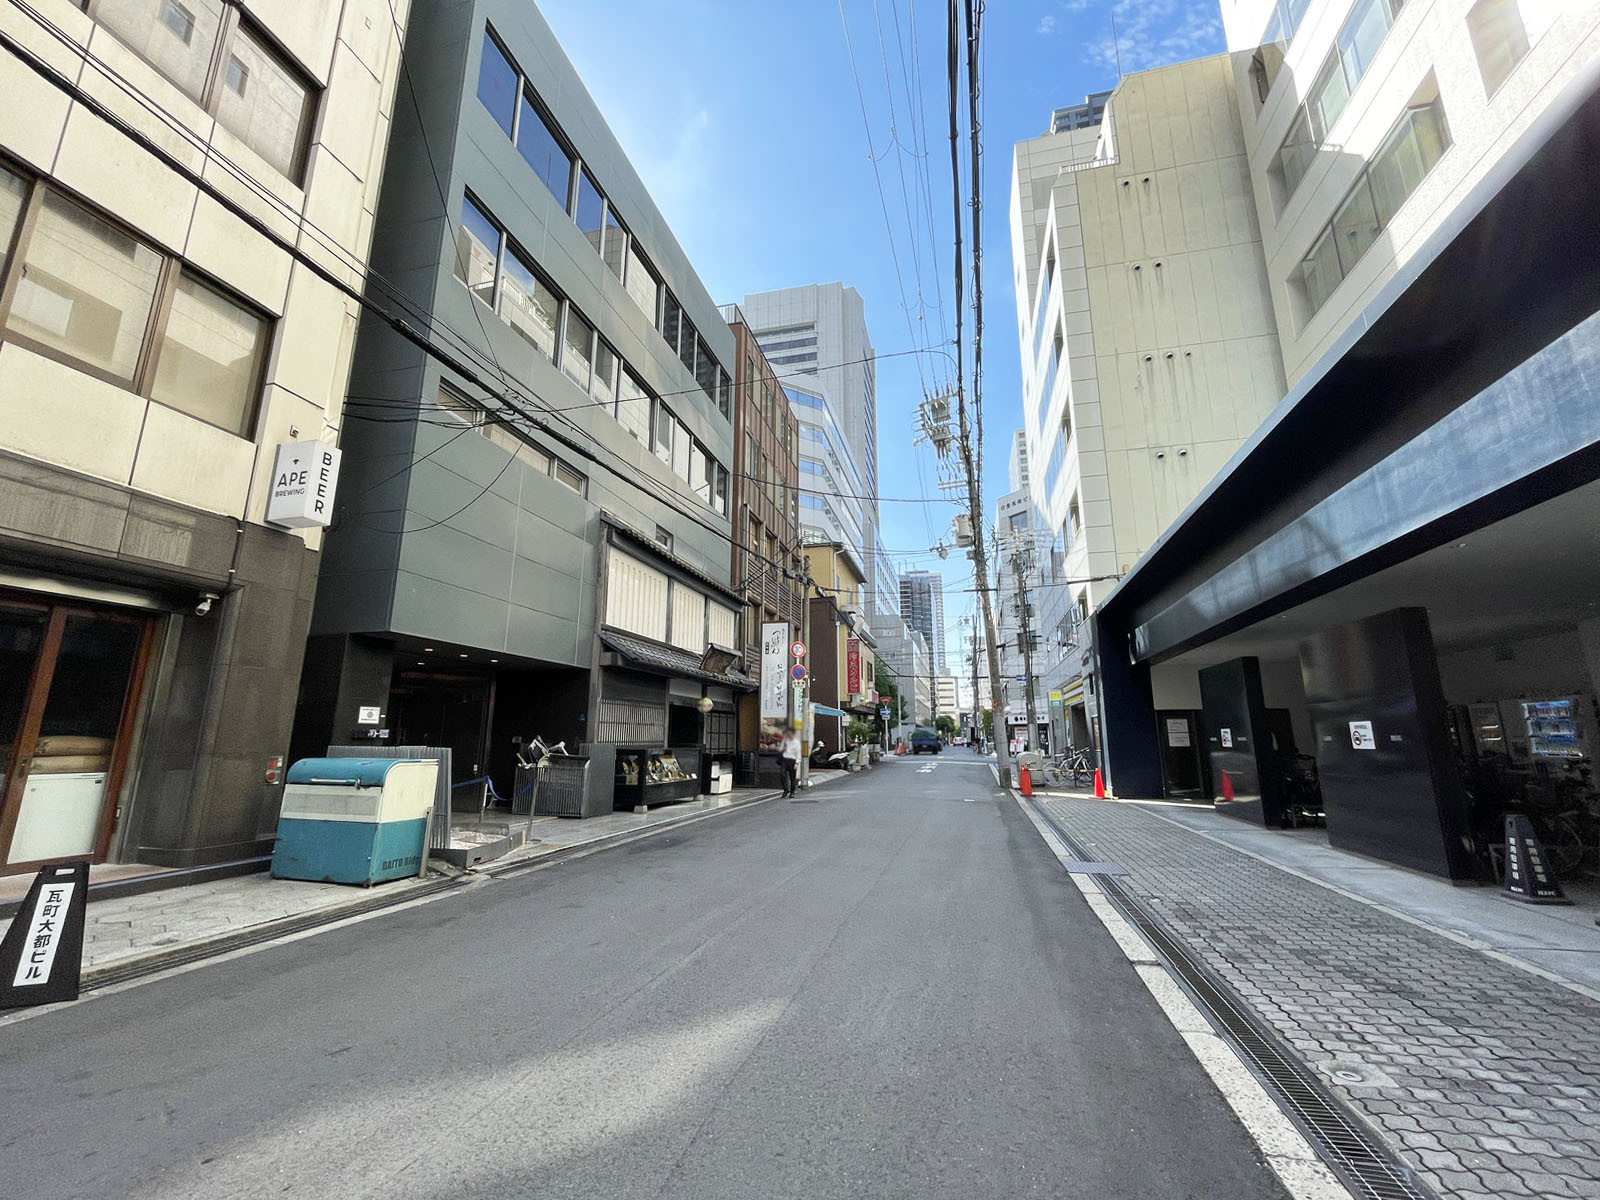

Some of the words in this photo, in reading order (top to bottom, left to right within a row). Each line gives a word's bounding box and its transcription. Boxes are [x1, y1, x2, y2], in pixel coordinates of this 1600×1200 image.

[275, 488, 305, 498] BREWING
[277, 470, 308, 488] APE
[314, 451, 333, 515] BEER
[24, 889, 65, 980] 瓦町大都ビル
